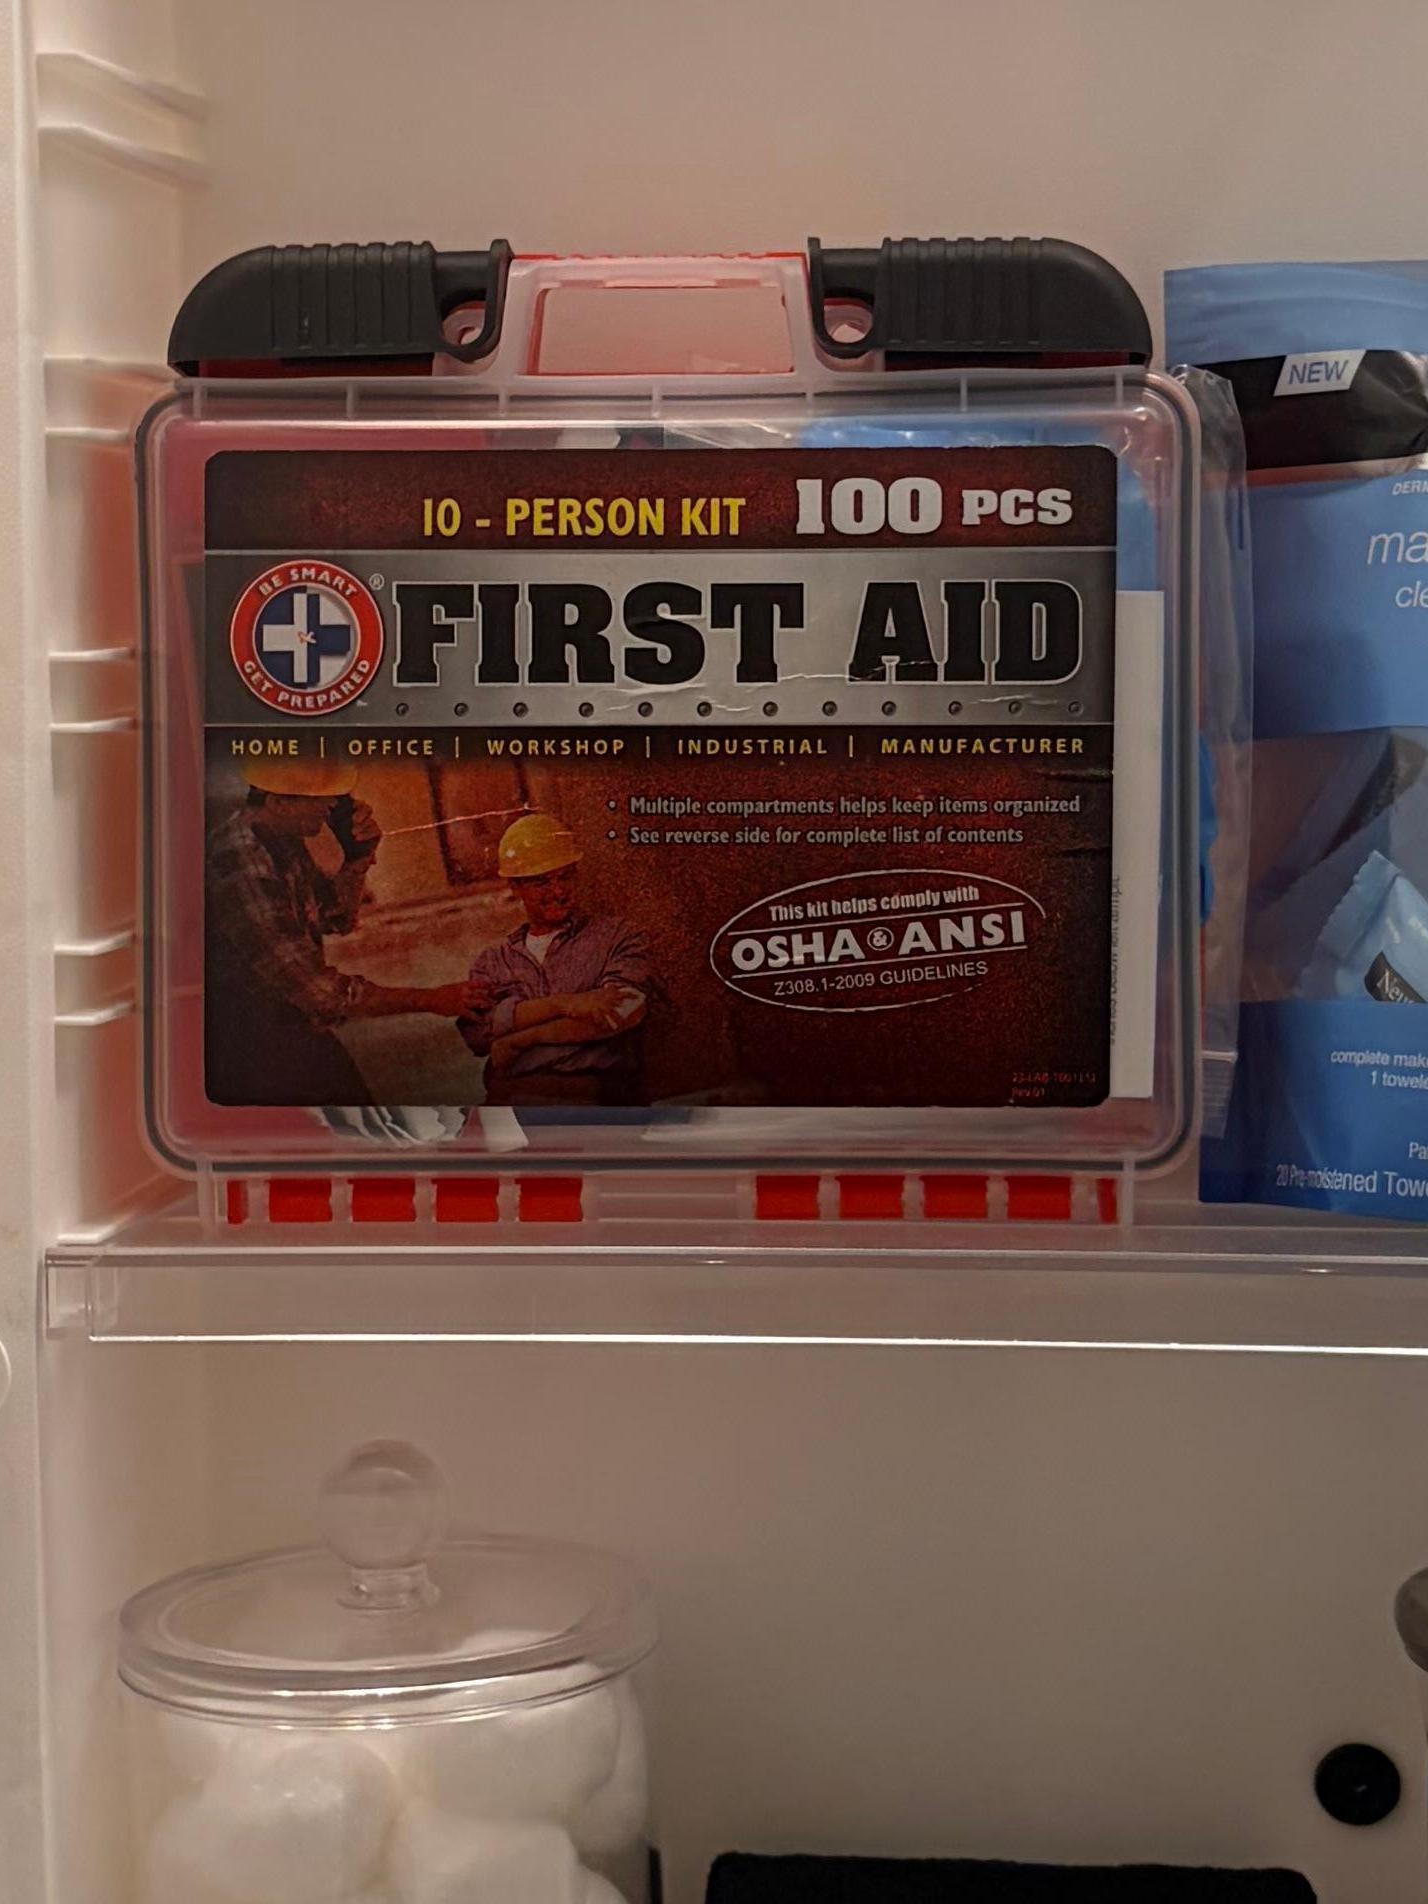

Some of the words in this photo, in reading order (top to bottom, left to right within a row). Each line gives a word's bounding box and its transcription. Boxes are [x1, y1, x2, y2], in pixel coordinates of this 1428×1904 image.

[1287, 360, 1350, 386] NEW
[424, 498, 461, 536] 10
[507, 498, 665, 535] PERSON
[681, 498, 746, 535] KIT
[797, 478, 943, 535] 100
[962, 487, 1073, 526] PCS
[259, 574, 283, 596] BE
[289, 567, 358, 597] SMART
[392, 580, 805, 687] FIRST
[845, 579, 1083, 685] AID
[244, 660, 273, 693] GET
[277, 659, 370, 709] PREPARED
[232, 739, 300, 756] HOME
[348, 739, 434, 756] OFFICE
[486, 739, 625, 756] WORKSHOP
[677, 738, 828, 755] INDUSTRIAL
[881, 738, 1084, 755] MANUFACTURER
[630, 797, 700, 818] Multiple
[706, 800, 834, 818] compartments
[840, 796, 887, 817] helps
[892, 797, 934, 817] keep
[939, 796, 988, 813] items
[993, 795, 1081, 817] organized
[630, 827, 659, 843] See
[665, 830, 730, 843] reverse
[734, 826, 770, 843] side
[775, 826, 801, 843] for
[806, 827, 887, 846] complete
[892, 825, 920, 842] list
[925, 825, 943, 842] of
[947, 827, 1024, 842] contents
[770, 905, 804, 921] This
[807, 900, 829, 917] kit
[831, 895, 877, 917] helps
[880, 890, 941, 911] comply
[943, 885, 980, 903] with
[731, 928, 866, 971] OSHA
[898, 910, 1025, 955] ANSI
[774, 972, 875, 996] Z308.1-2009
[880, 960, 989, 985] GUIDELINES
[1330, 1049, 1390, 1066] complete
